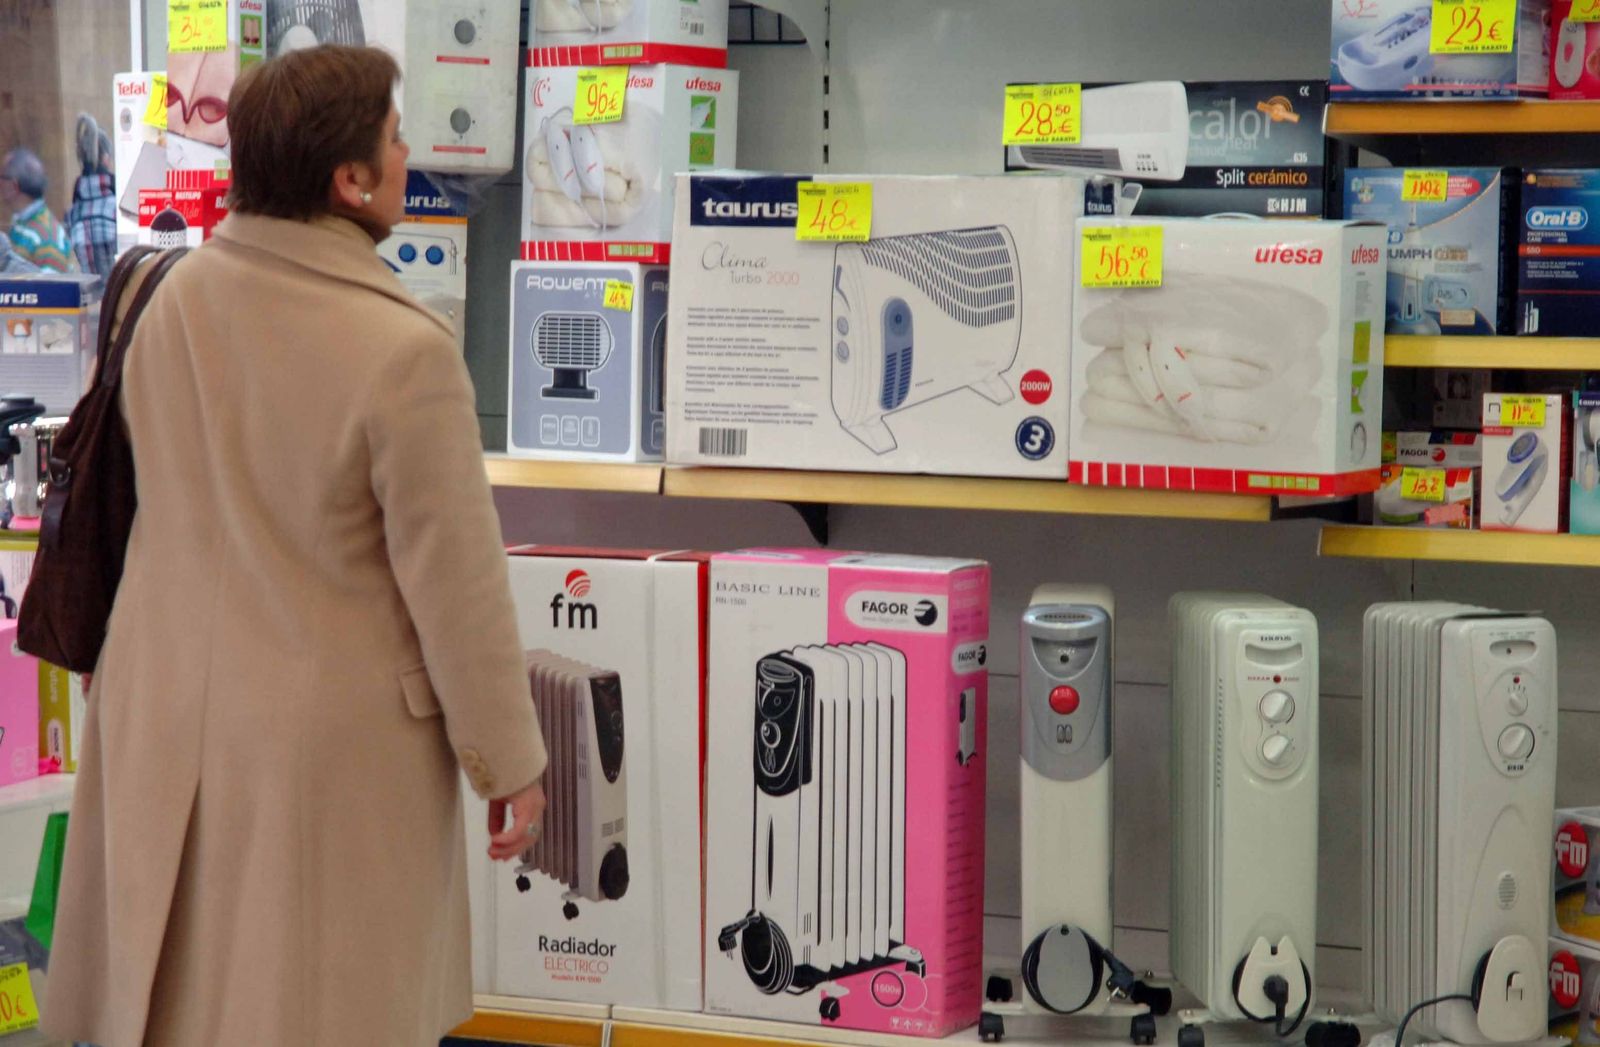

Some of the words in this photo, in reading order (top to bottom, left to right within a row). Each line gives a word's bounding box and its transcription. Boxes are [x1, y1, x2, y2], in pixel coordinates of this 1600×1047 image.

[116, 81, 147, 96] Tefal
[686, 76, 721, 92] ufesa
[1216, 168, 1245, 189] Split
[1248, 168, 1308, 186] cerámico
[702, 197, 798, 218] taurus
[1087, 201, 1112, 213] taurus
[701, 241, 768, 270] Clima
[1254, 241, 1324, 265] ufesa
[1351, 243, 1379, 265] ufesa
[730, 271, 762, 284] Turbo
[766, 271, 800, 285] 2000
[1021, 380, 1051, 392] 2000W
[1024, 424, 1046, 452] 3
[1400, 448, 1429, 457] FAGOR
[716, 581, 770, 595] BASIC
[778, 584, 821, 599] LINE
[550, 592, 598, 630] fm
[861, 600, 909, 616] FAGOR
[958, 650, 976, 662] FAGOR
[1555, 832, 1587, 867] fm
[538, 934, 617, 957] Radiador
[543, 955, 609, 975] ELECTRICO
[1549, 961, 1580, 997] fm
